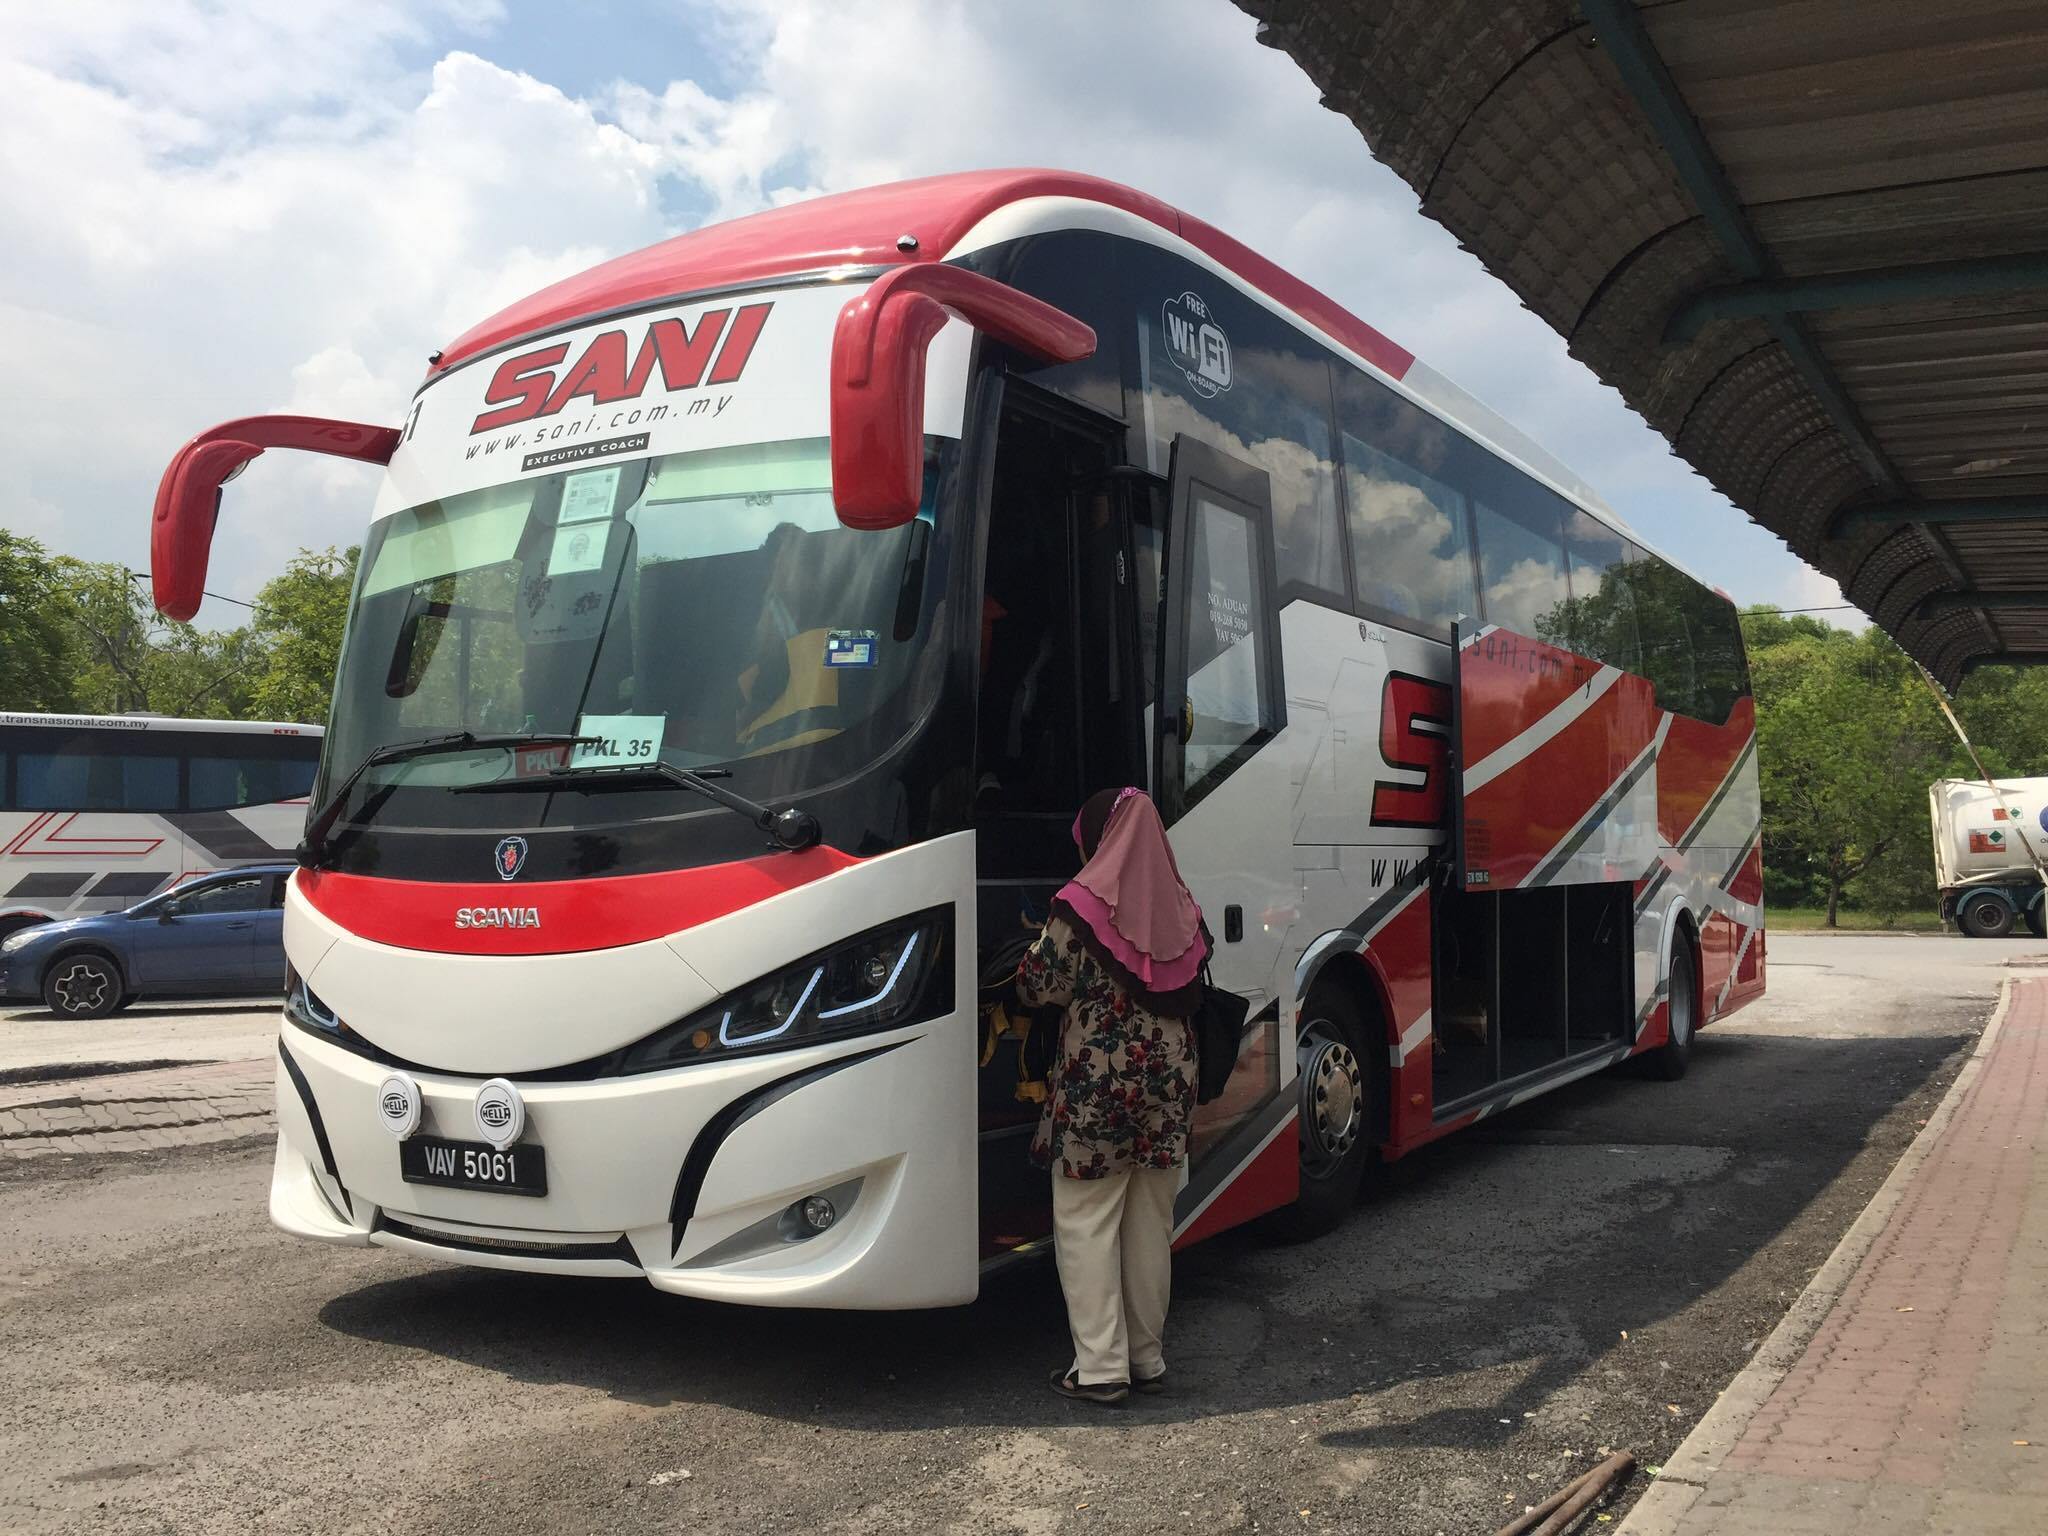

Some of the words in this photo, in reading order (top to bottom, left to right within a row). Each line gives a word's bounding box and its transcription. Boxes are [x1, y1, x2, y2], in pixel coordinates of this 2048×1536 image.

[1186, 295, 1206, 319] FREE
[469, 301, 775, 436] SANI
[465, 395, 733, 461] www.sani.com.my
[526, 445, 596, 467] EXECUTIVE
[601, 438, 646, 454] COACH
[1207, 592, 1221, 608] NO.
[1222, 598, 1248, 615] ADUAN
[1215, 628, 1228, 642] VAV
[581, 739, 621, 757] PKL
[627, 739, 653, 757] 35
[455, 906, 541, 930] SCANIA
[384, 1098, 409, 1112] HELLA
[482, 1107, 511, 1120] HELLA
[424, 1146, 457, 1177] VAV
[464, 1150, 516, 1184] 5061
